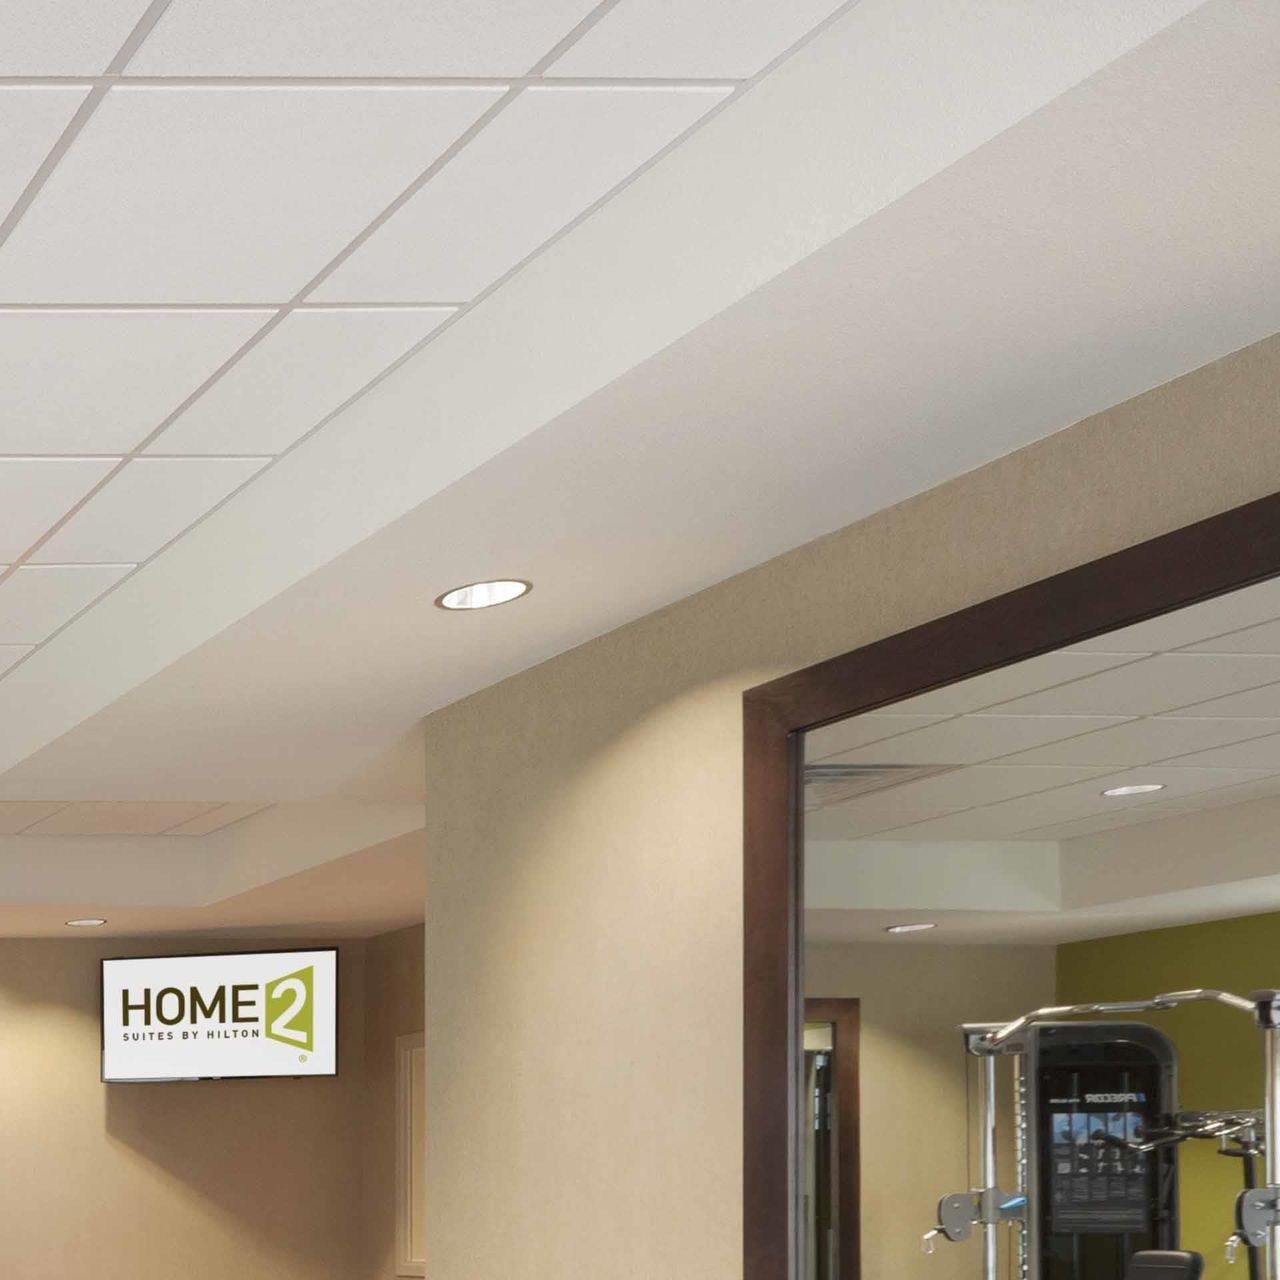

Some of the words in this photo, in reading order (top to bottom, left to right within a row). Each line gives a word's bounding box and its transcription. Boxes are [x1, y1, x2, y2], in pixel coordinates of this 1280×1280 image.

[121, 983, 260, 1027] HOME
[122, 1031, 175, 1042] SUITES
[182, 1030, 199, 1041] BY
[206, 1029, 260, 1040] HILTON
